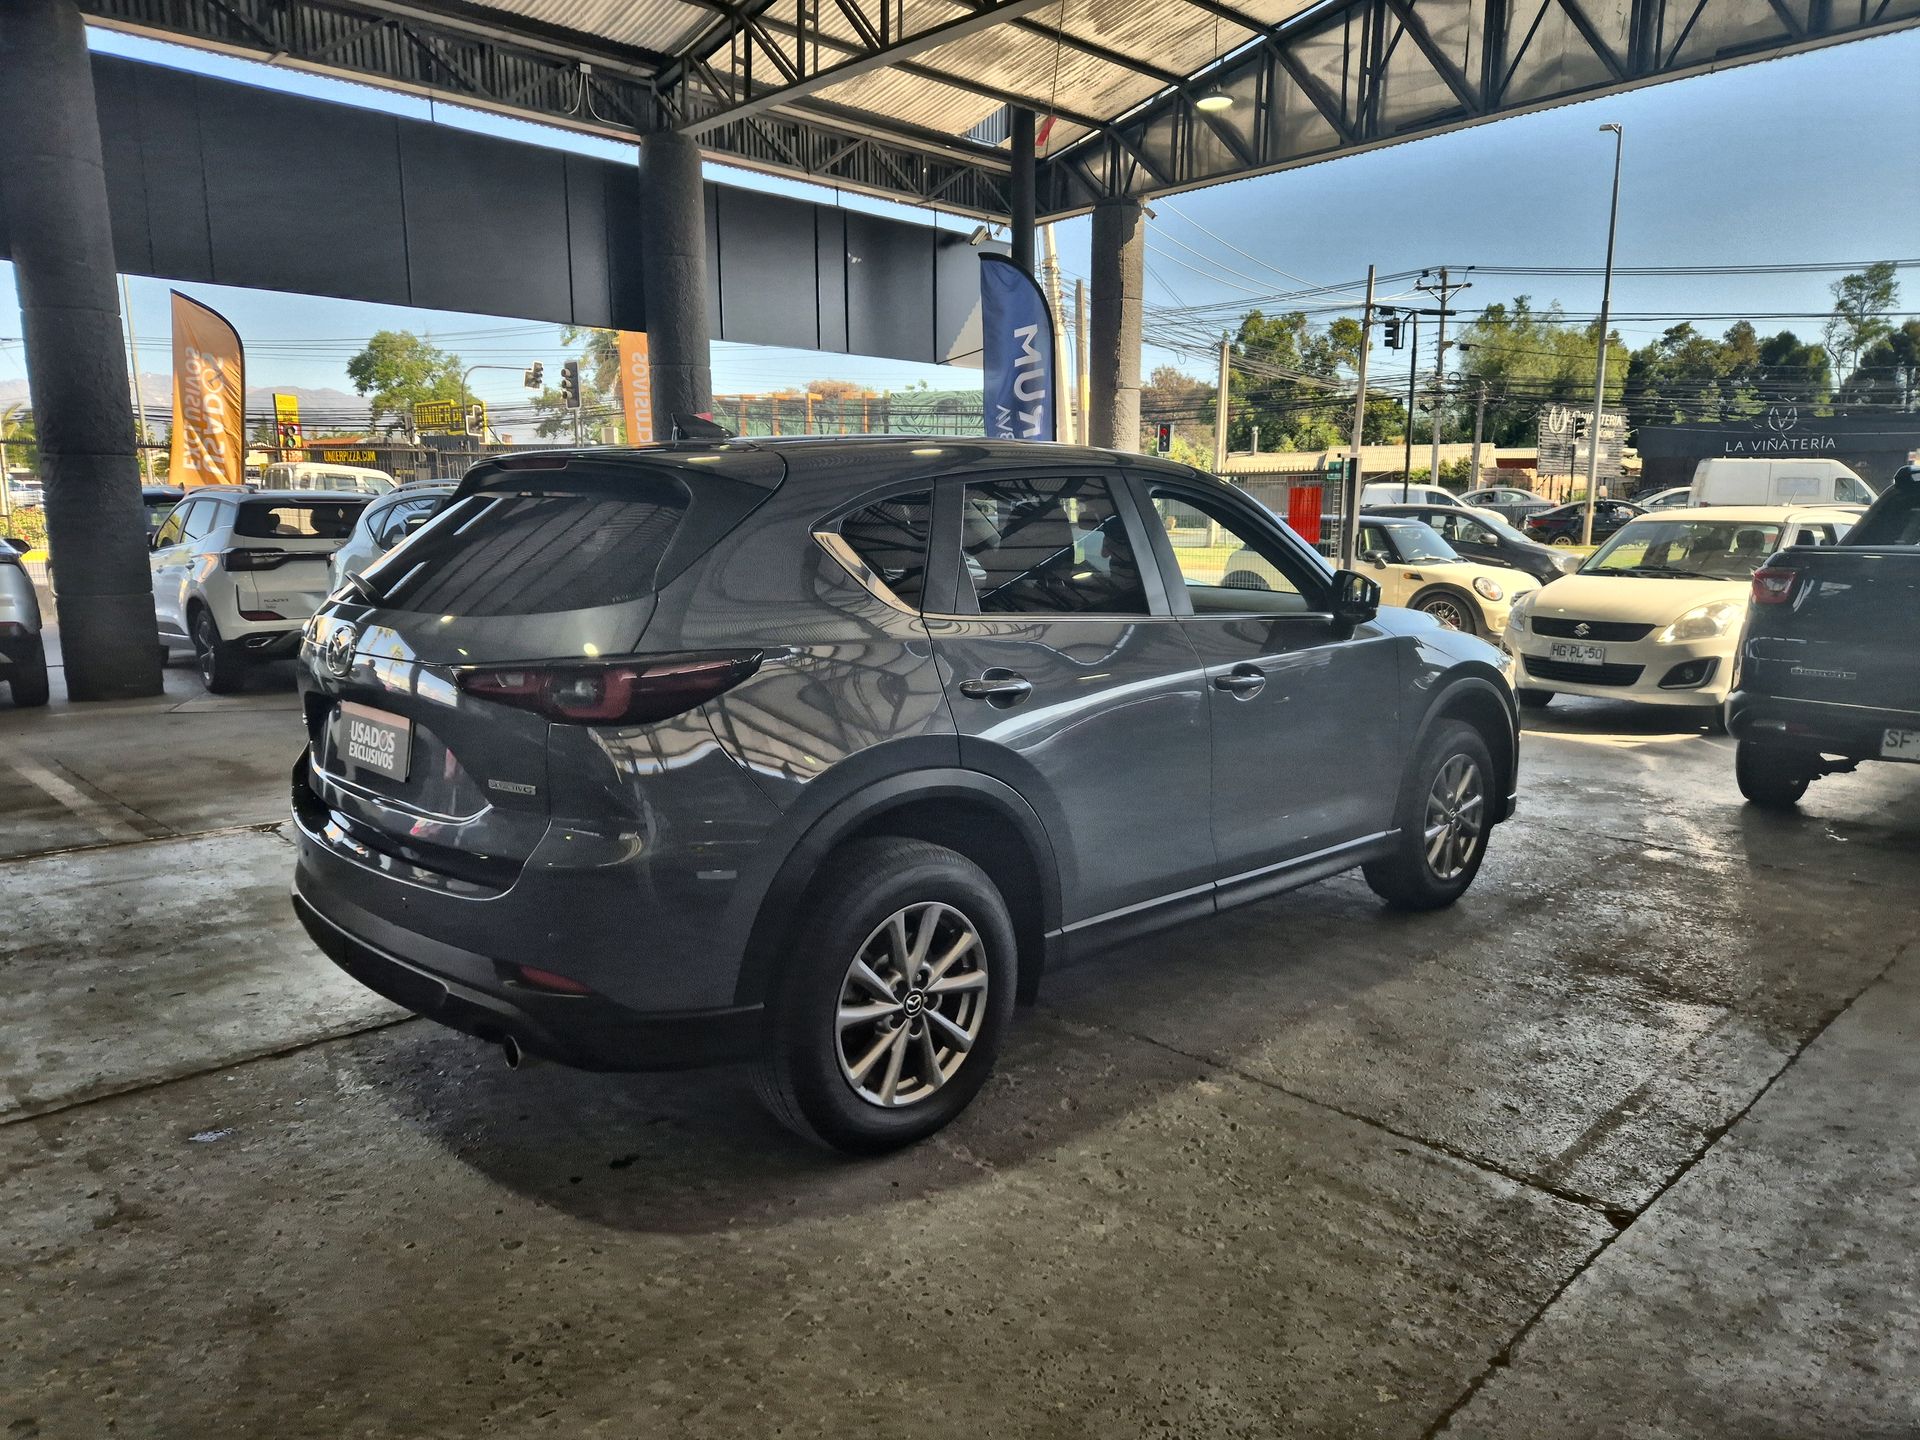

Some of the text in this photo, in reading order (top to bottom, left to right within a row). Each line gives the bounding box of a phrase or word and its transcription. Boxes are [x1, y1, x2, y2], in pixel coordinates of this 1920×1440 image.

[1725, 435, 1836, 452] LA VIÑATERÍA
[323, 450, 377, 462] UNDERPIZZA.COM
[350, 720, 396, 753] USADOS
[349, 741, 394, 770] EXCLUSIVOS
